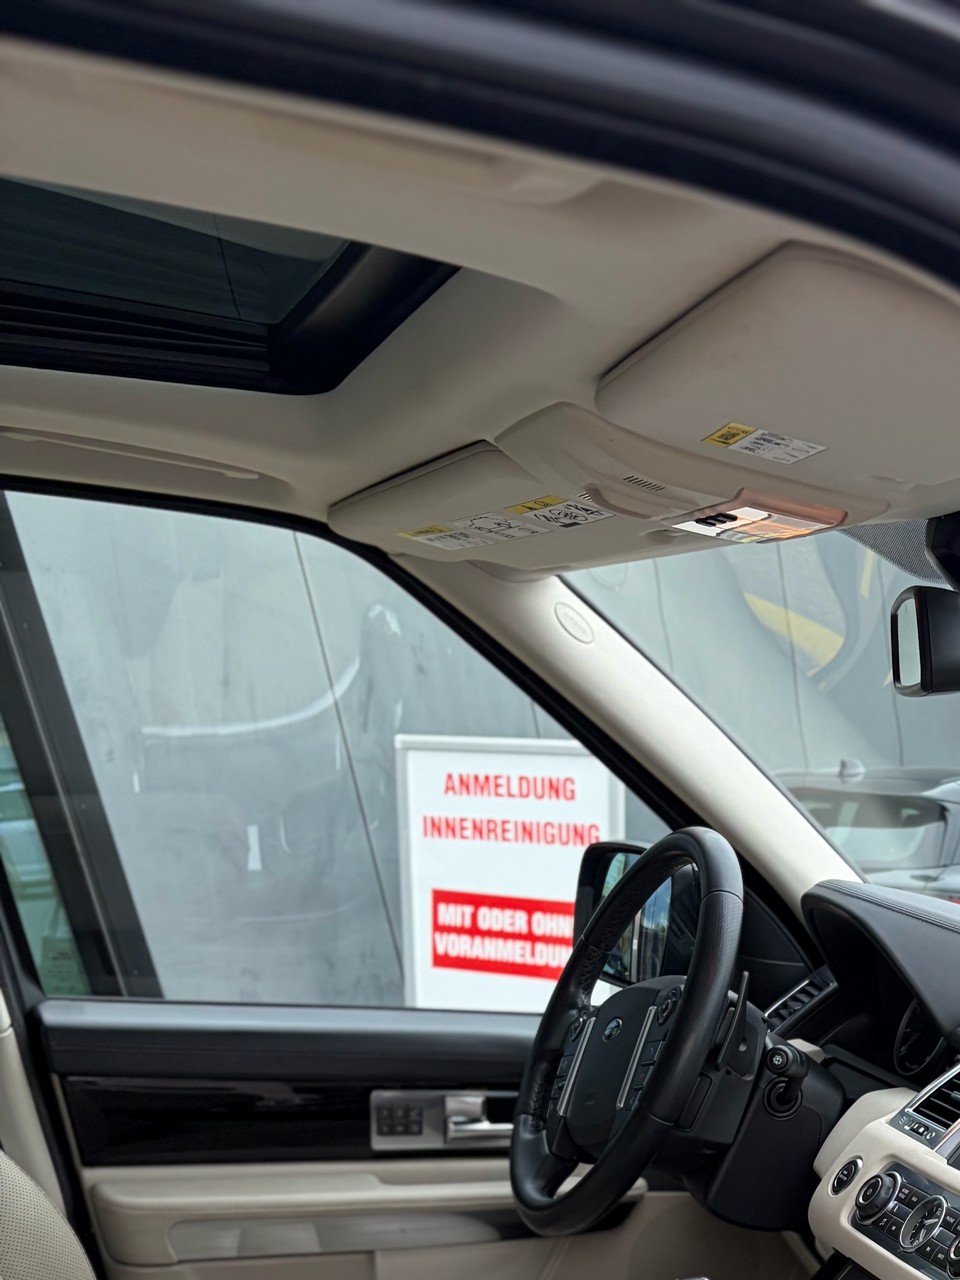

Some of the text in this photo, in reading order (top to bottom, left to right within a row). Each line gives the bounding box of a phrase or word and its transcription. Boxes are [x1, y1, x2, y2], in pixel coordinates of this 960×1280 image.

[444, 772, 576, 801] ANMELDUNG
[422, 815, 600, 846] INNENREINIGUNG
[437, 902, 575, 938] MIT ODER OHN
[433, 930, 574, 969] VORANMELDUN
